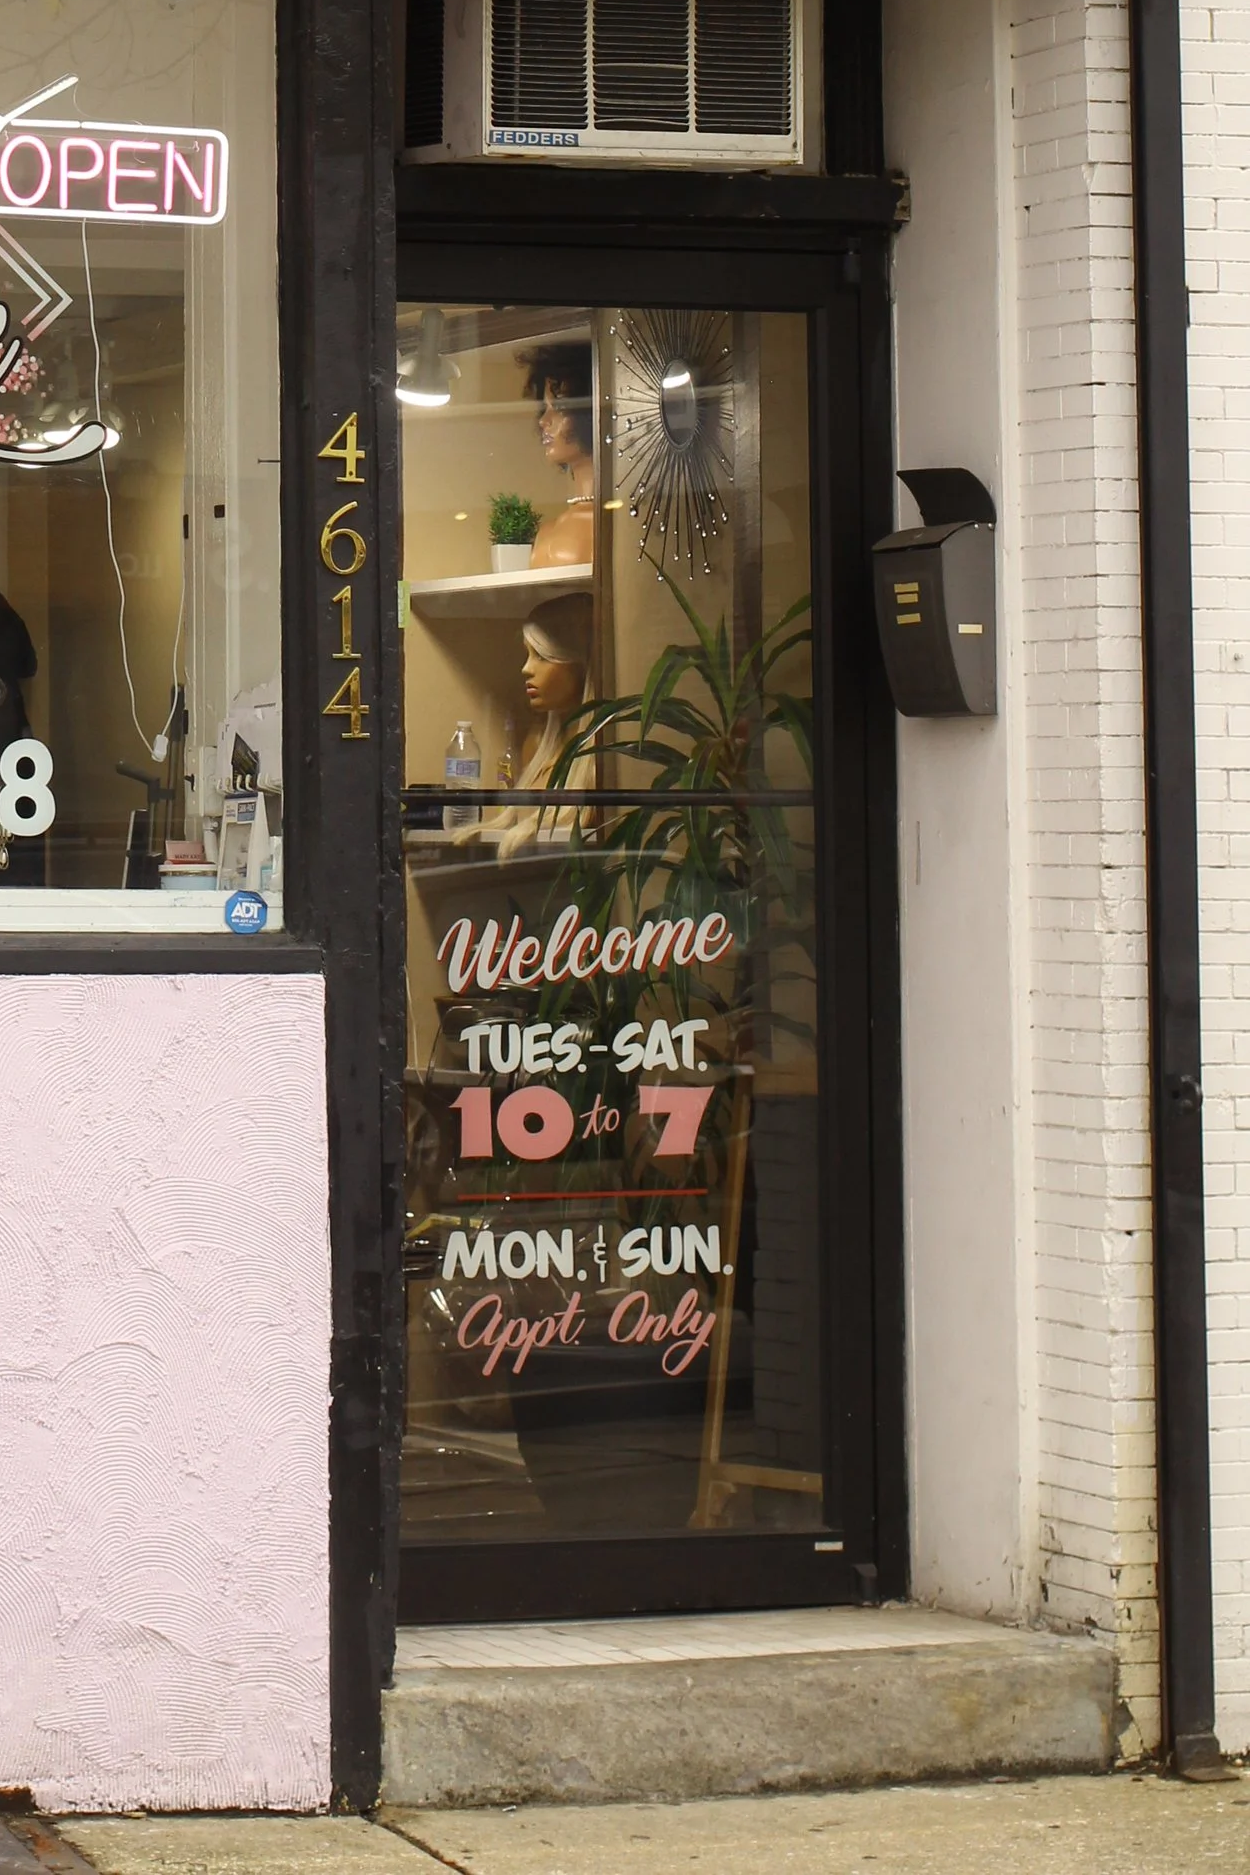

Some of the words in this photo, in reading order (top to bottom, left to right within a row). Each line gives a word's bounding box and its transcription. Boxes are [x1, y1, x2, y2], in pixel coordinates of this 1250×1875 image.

[0, 132, 220, 213] OPEN
[492, 131, 576, 146] FEDDERS
[317, 411, 371, 739] 4614
[231, 901, 262, 919] ADT
[437, 904, 734, 994] Welcome
[449, 1085, 575, 1161] 10
[580, 1093, 621, 1140] to
[638, 1085, 716, 1158] 7
[442, 1228, 587, 1282] MON.
[617, 1224, 734, 1279] SUN.
[608, 1288, 718, 1377] Only
